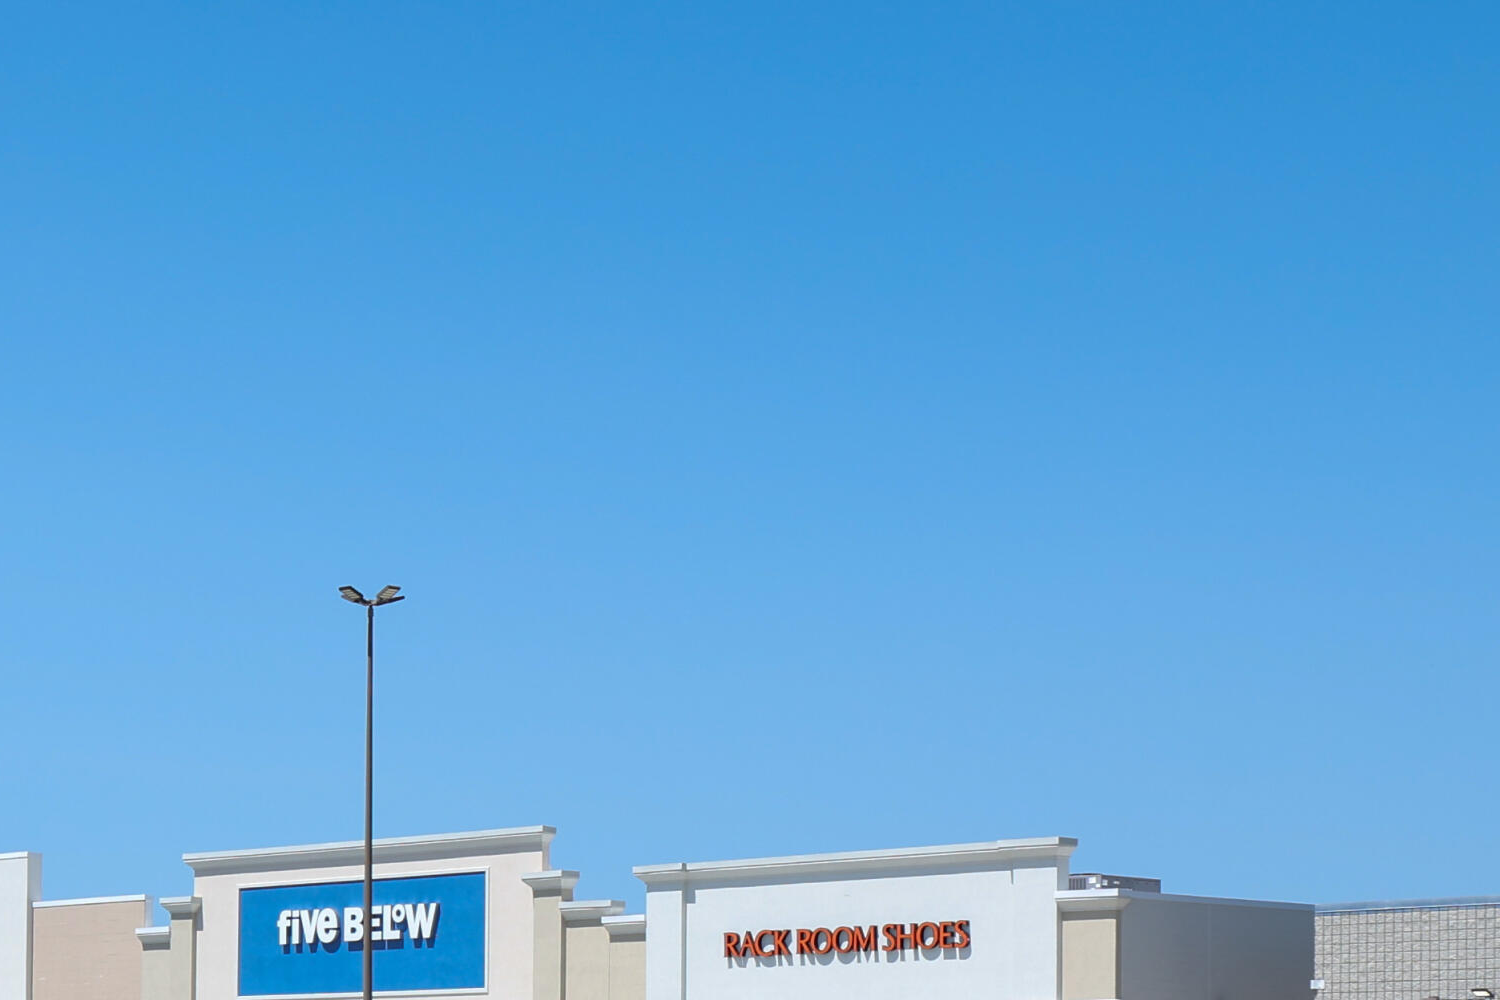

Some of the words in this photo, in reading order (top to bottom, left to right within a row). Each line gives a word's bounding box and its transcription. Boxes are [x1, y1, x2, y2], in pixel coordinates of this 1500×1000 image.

[277, 907, 339, 945] five
[723, 929, 792, 958] RACK
[796, 925, 878, 955] ROOM
[882, 920, 970, 952] SHOES
